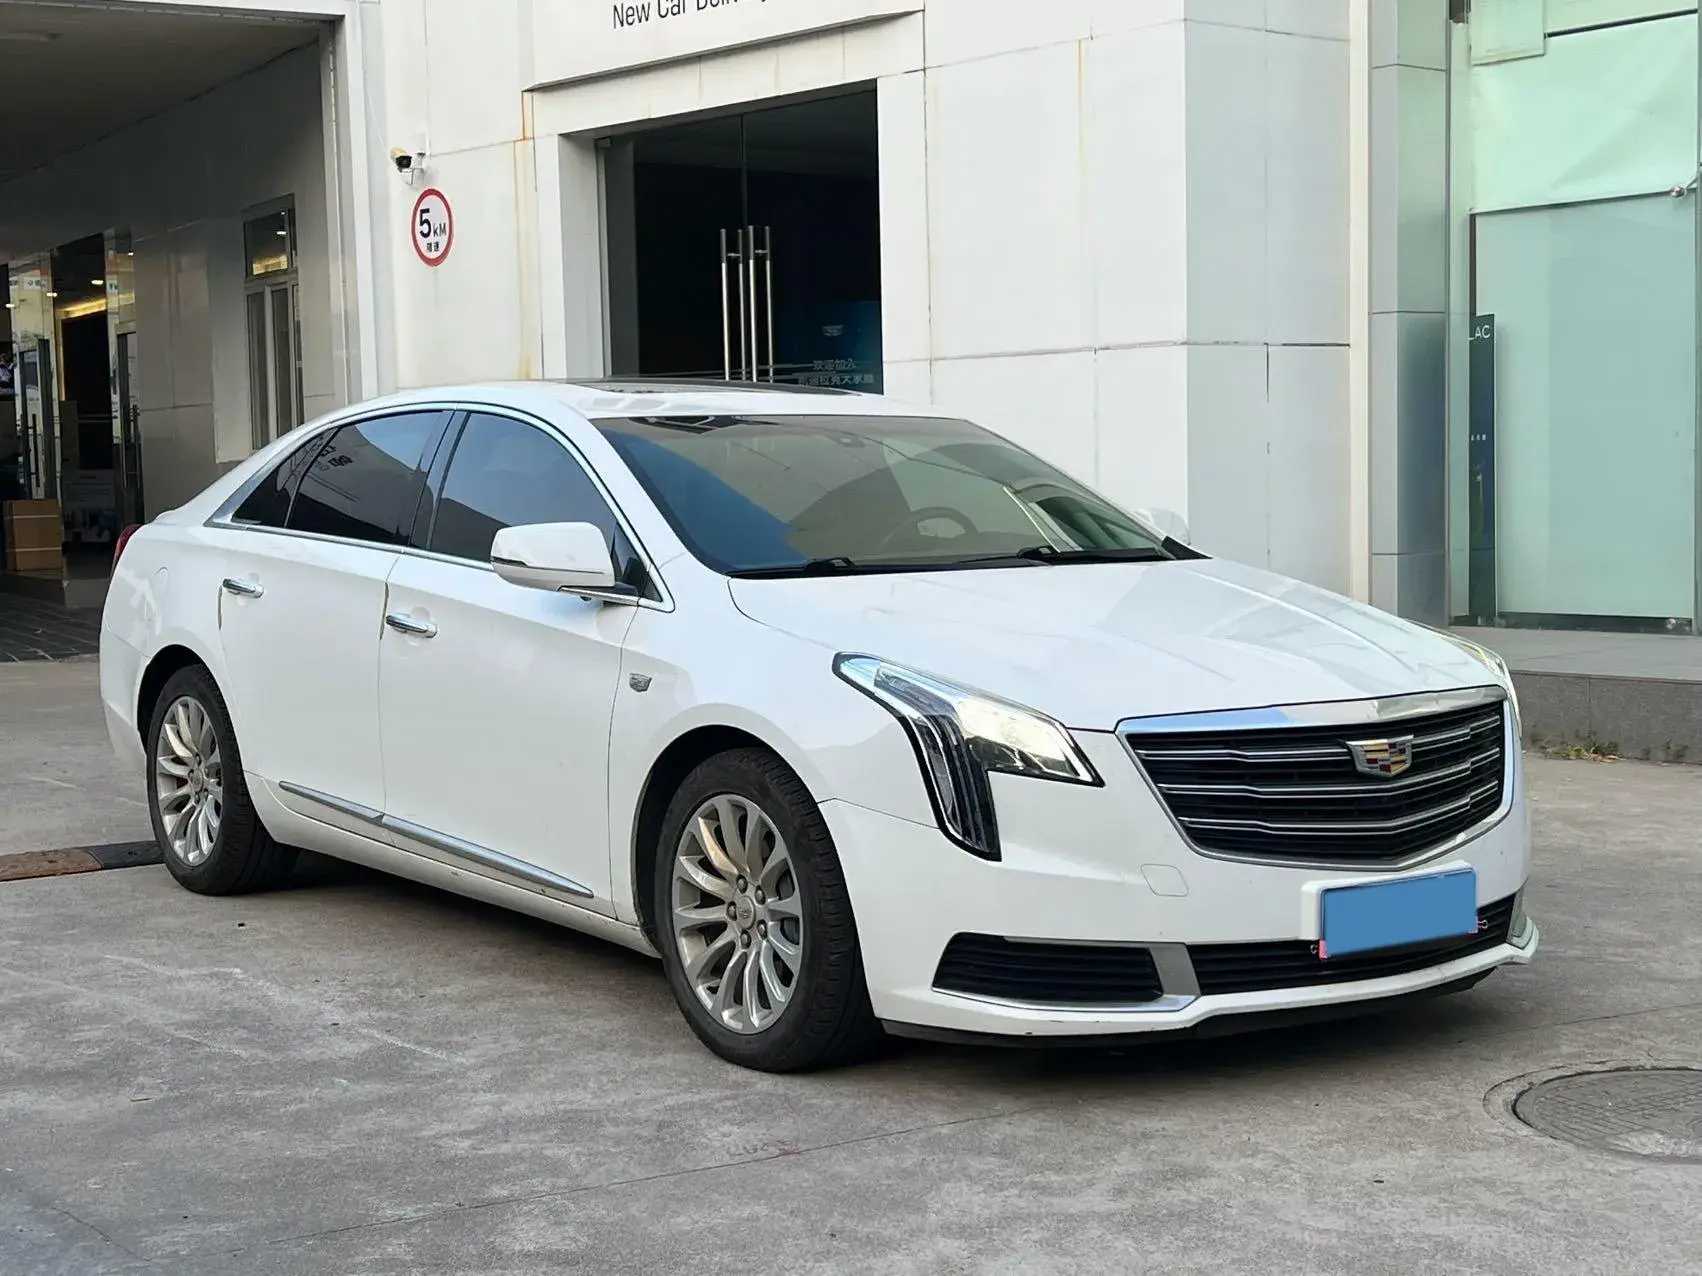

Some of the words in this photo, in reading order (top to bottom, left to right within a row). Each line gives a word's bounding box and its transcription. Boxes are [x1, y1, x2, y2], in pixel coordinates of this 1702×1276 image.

[613, 3, 650, 28] New
[657, 0, 686, 18] Car
[1468, 325, 1491, 340] AC
